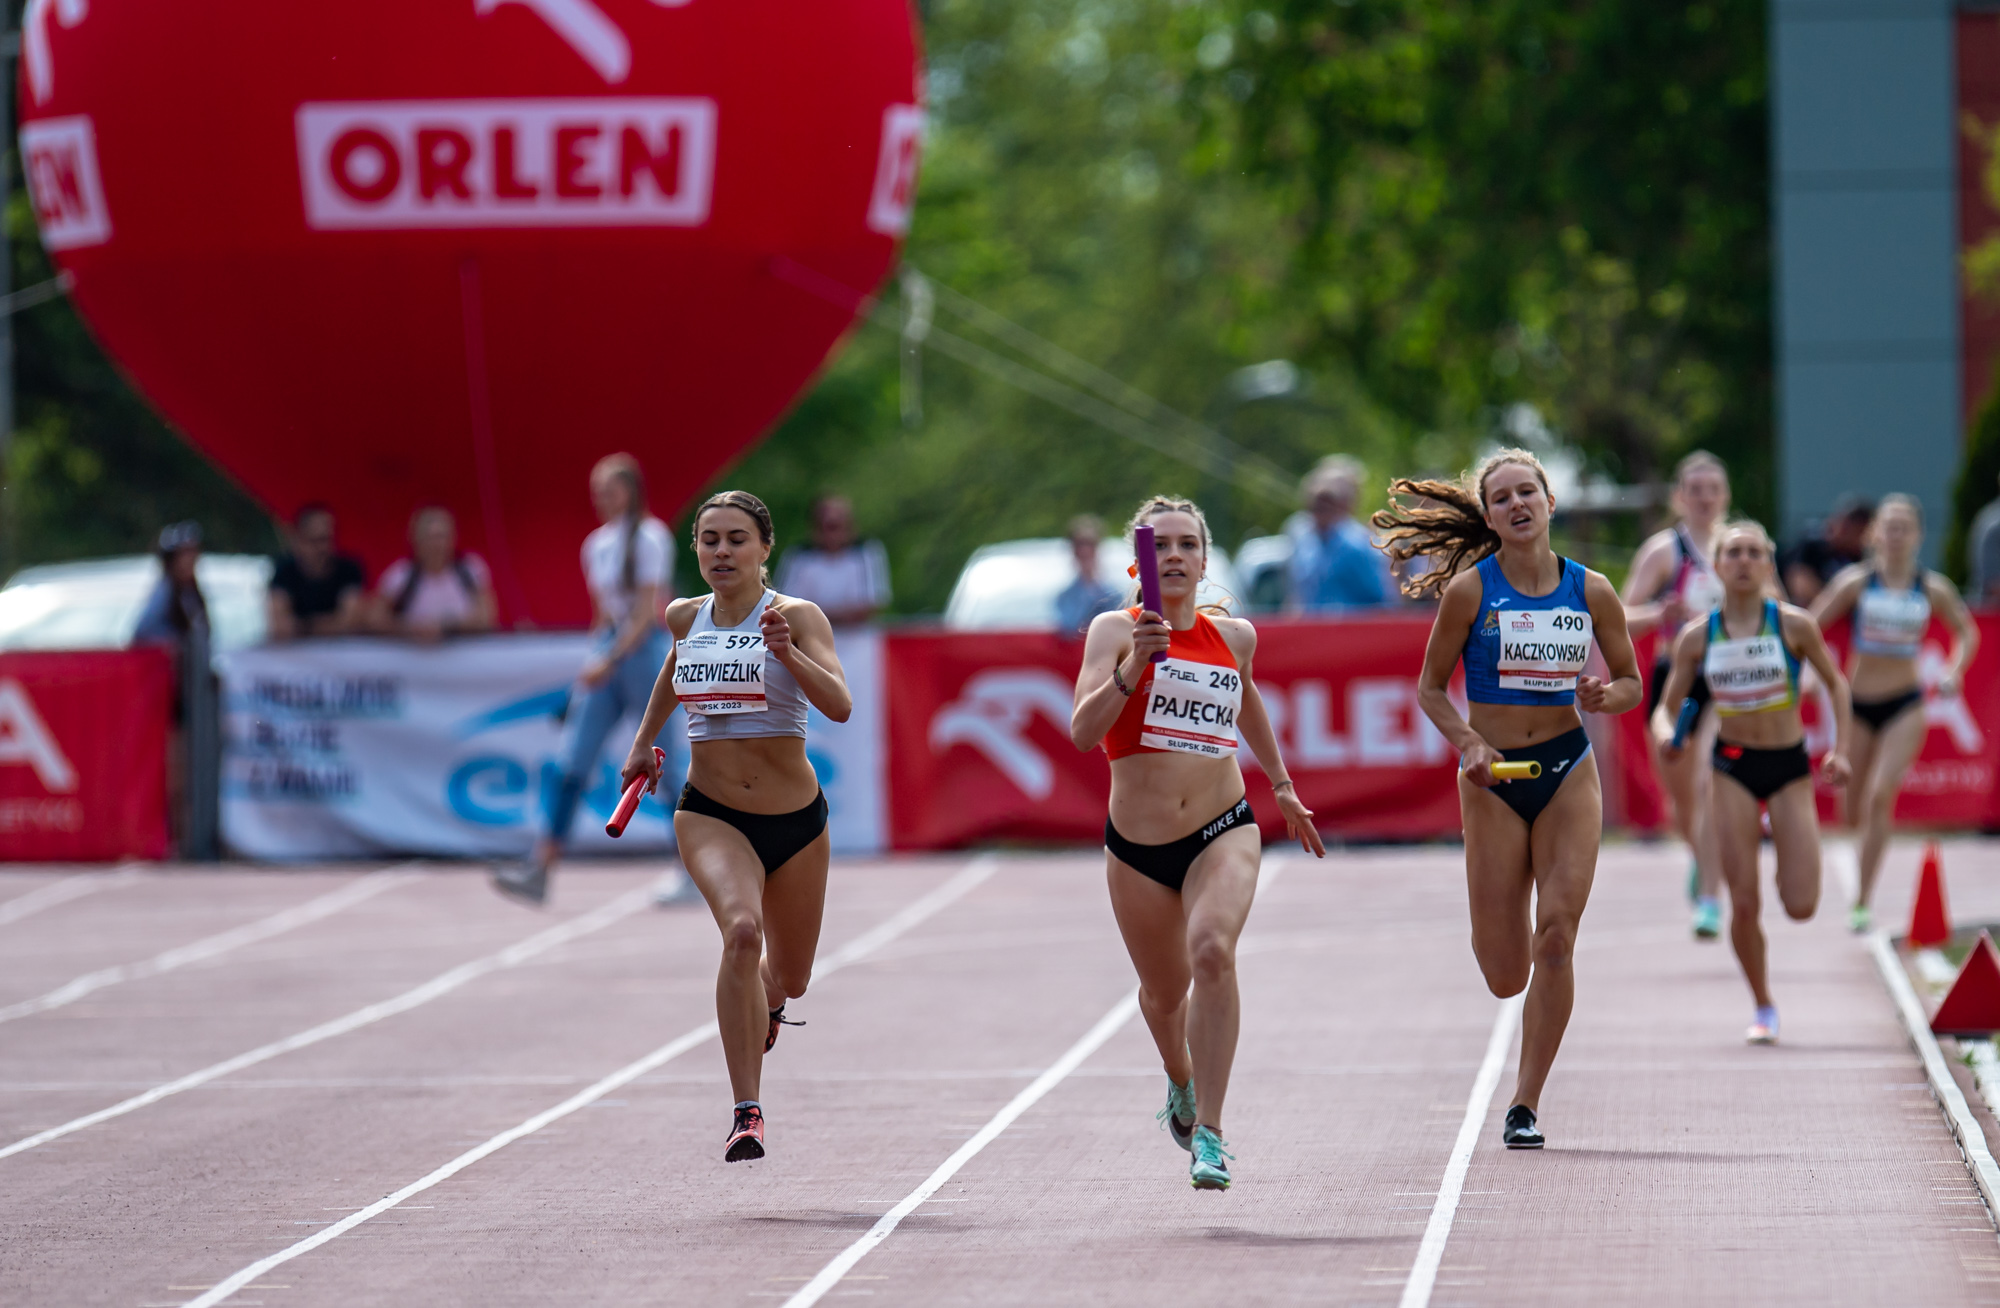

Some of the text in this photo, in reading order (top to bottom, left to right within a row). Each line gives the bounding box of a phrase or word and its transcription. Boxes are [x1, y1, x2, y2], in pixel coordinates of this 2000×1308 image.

[327, 121, 684, 205] ORLEN
[1553, 615, 1584, 631] 490
[725, 635, 762, 650] 597
[1504, 643, 1586, 662] KACZKOWSKA
[675, 659, 761, 683] PRZEWIEŹLIK
[1169, 668, 1200, 683] FUEL
[1209, 671, 1239, 692] 249
[1523, 679, 1553, 688] SŁUPSK
[1151, 694, 1234, 728] PAJĘCKA
[1168, 740, 1220, 754] SŁUPSK 2023
[1203, 799, 1248, 840] NIKE PR
